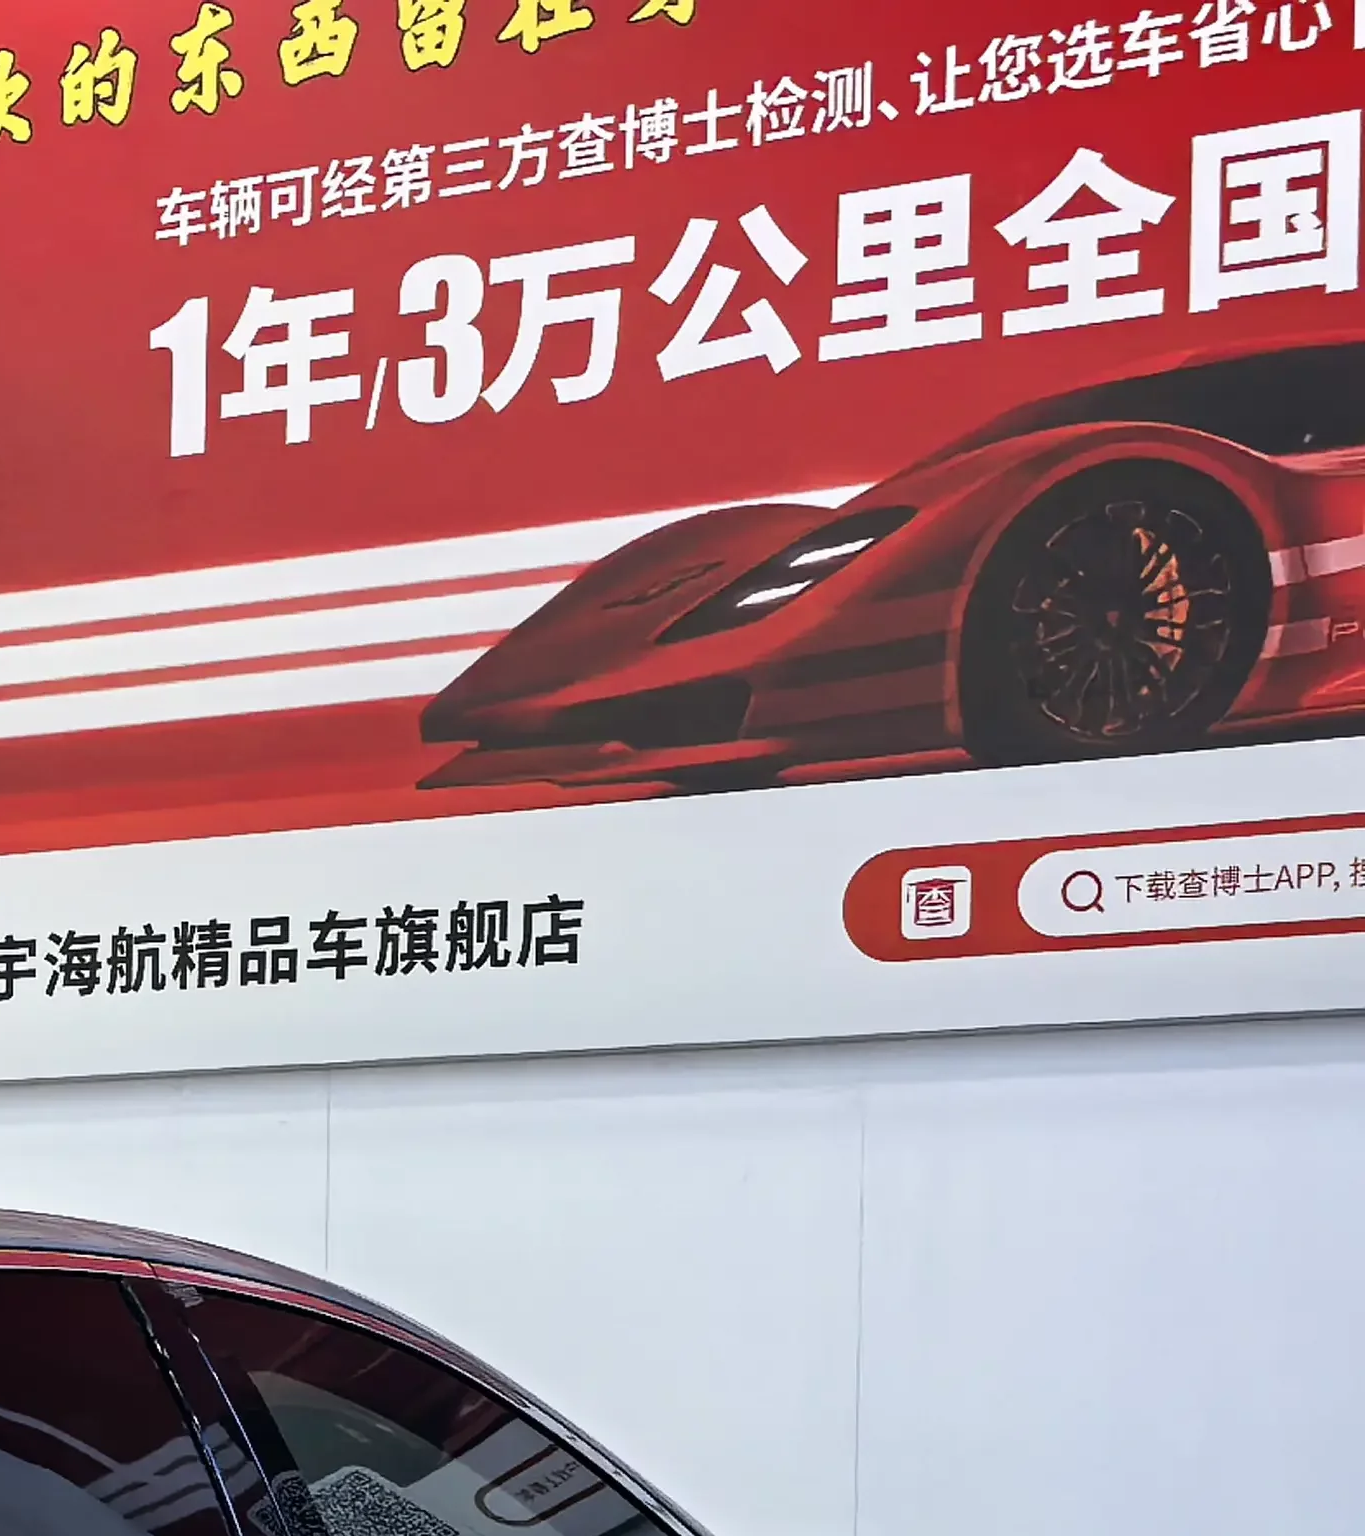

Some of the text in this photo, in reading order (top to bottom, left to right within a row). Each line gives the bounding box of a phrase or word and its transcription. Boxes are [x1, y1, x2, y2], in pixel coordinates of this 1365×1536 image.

[155, 0, 1365, 246] 车辆可经第三方查博士检测、让您选车省心
[149, 109, 1362, 457] 1年/3万公里全国
